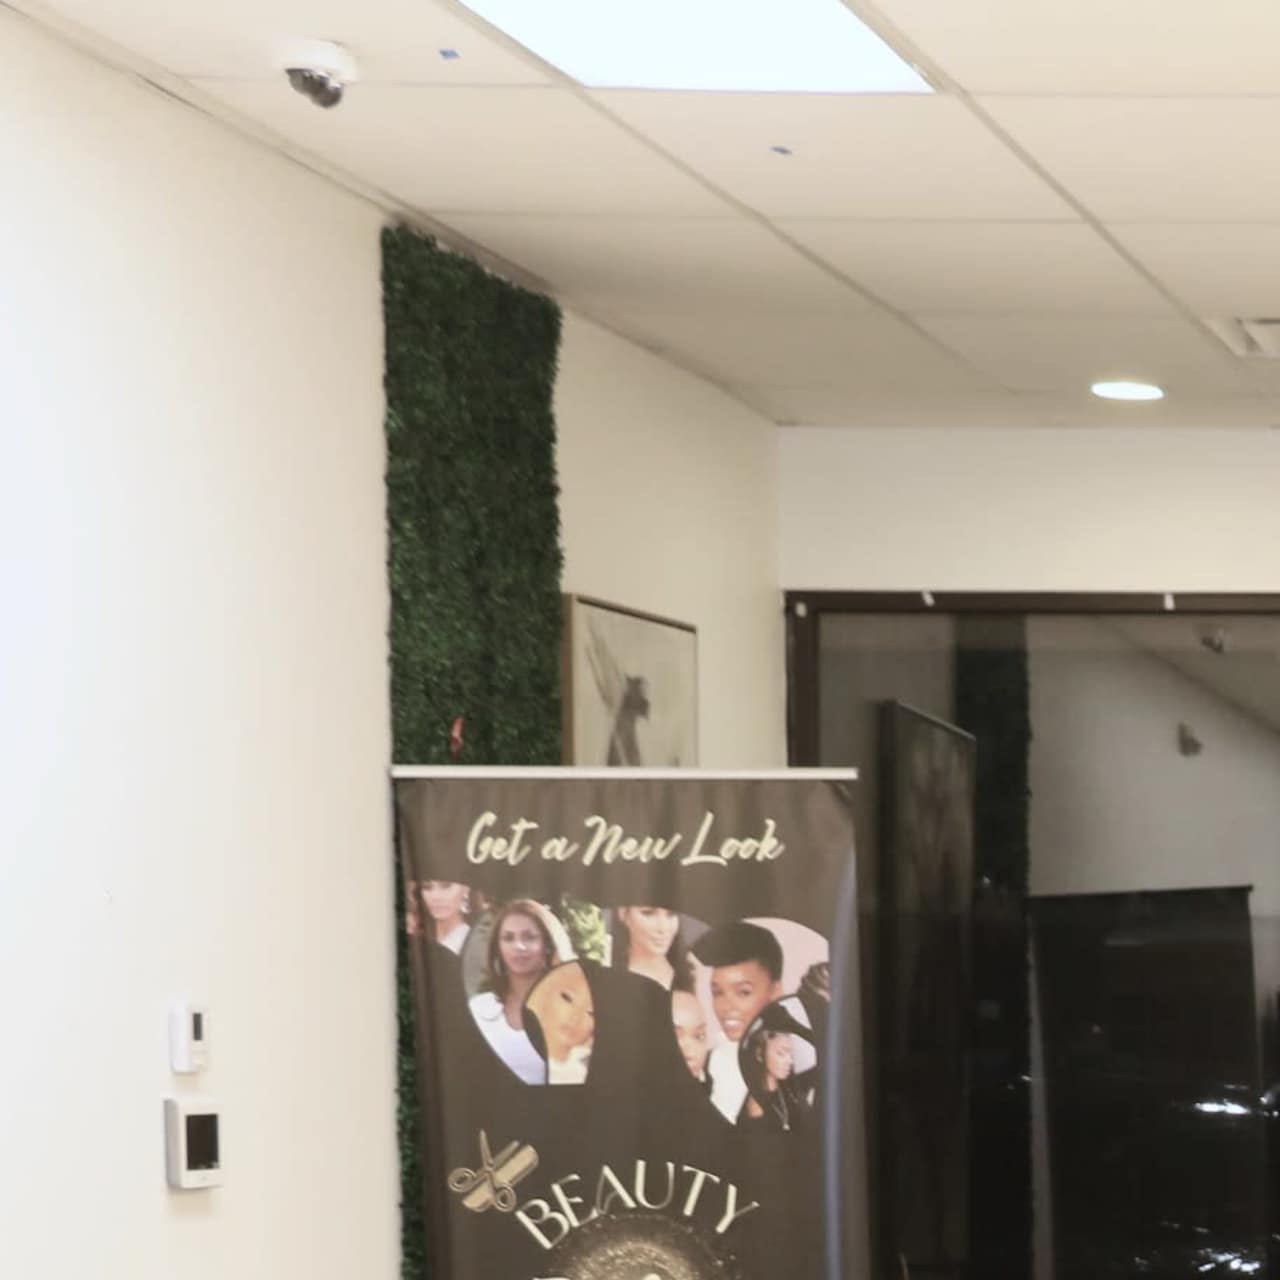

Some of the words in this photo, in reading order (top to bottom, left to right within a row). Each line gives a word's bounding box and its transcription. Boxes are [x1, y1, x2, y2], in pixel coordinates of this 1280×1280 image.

[467, 811, 538, 866] Get
[541, 832, 579, 859] a
[582, 815, 681, 866] New
[681, 811, 785, 866] Look
[515, 1159, 760, 1250] BEAUTY
